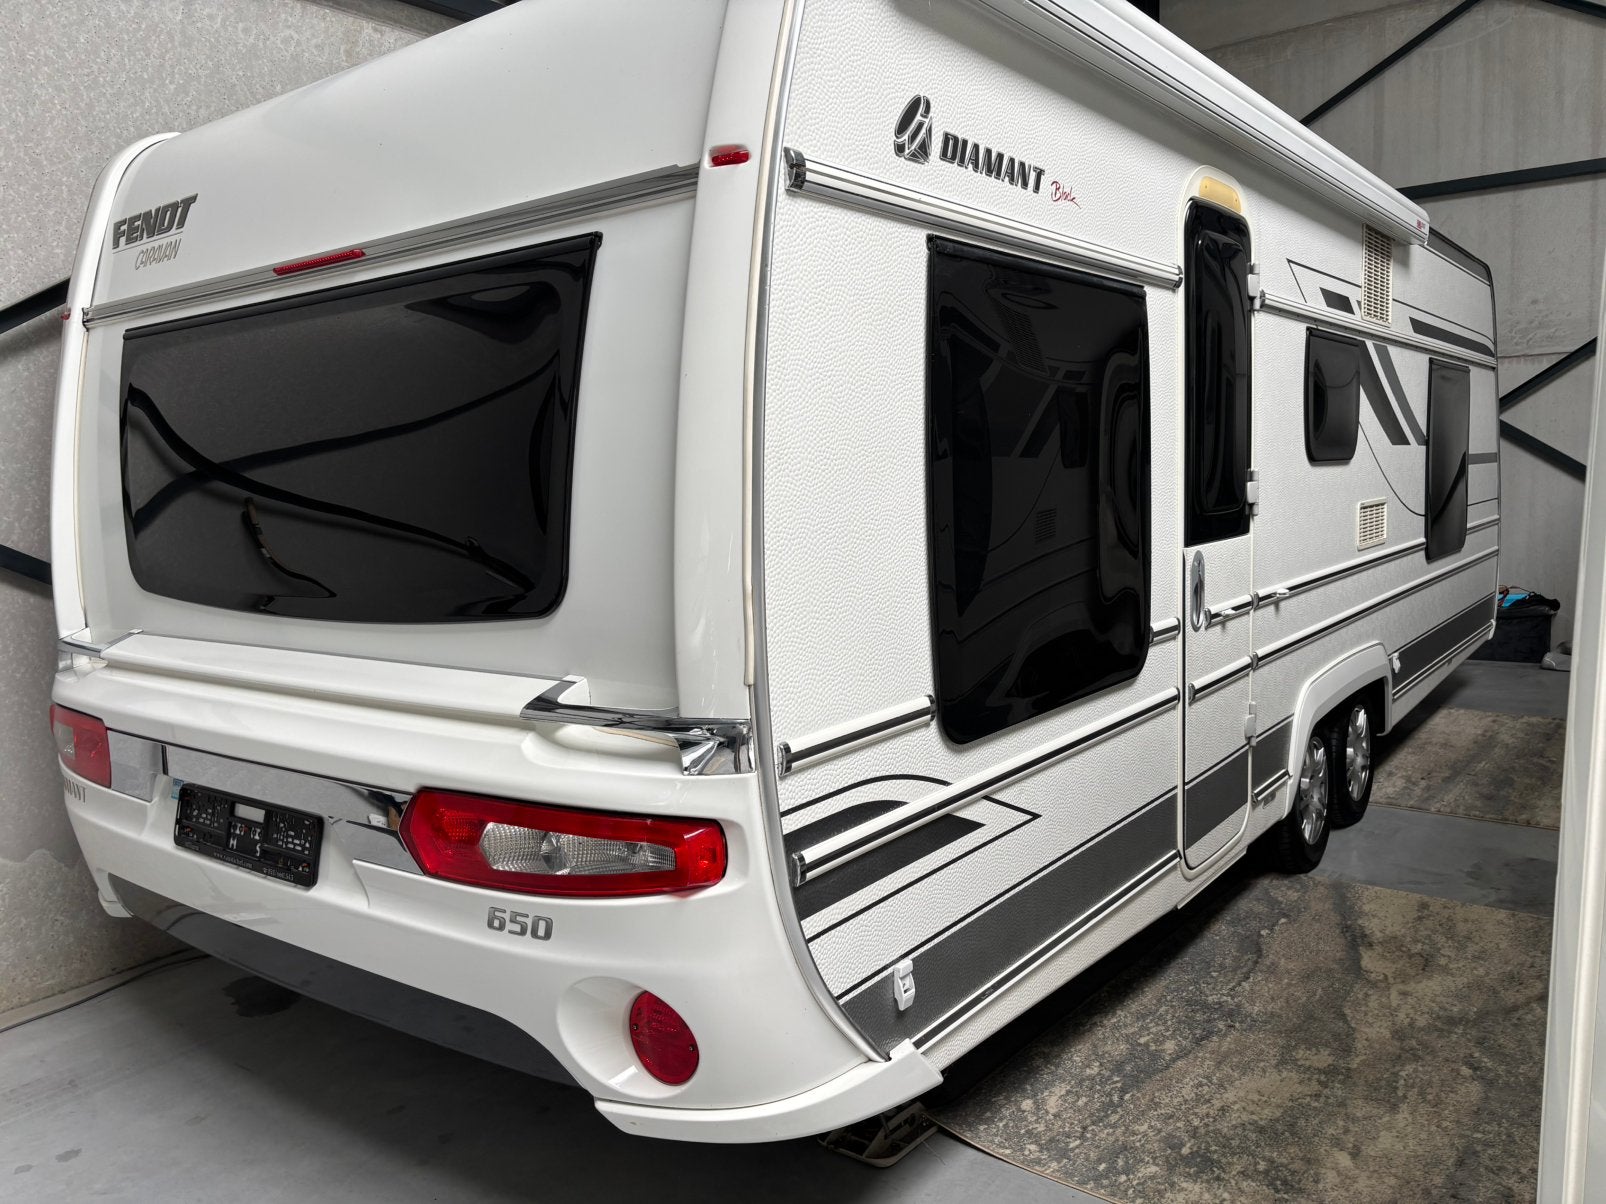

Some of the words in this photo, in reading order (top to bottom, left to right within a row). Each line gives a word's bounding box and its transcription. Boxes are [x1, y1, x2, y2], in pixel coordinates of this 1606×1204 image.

[939, 130, 1045, 194] DIAMANT
[1050, 180, 1082, 210] Black
[112, 193, 198, 250] FENDT
[135, 238, 182, 271] CARAVAN
[487, 906, 554, 941] 650
